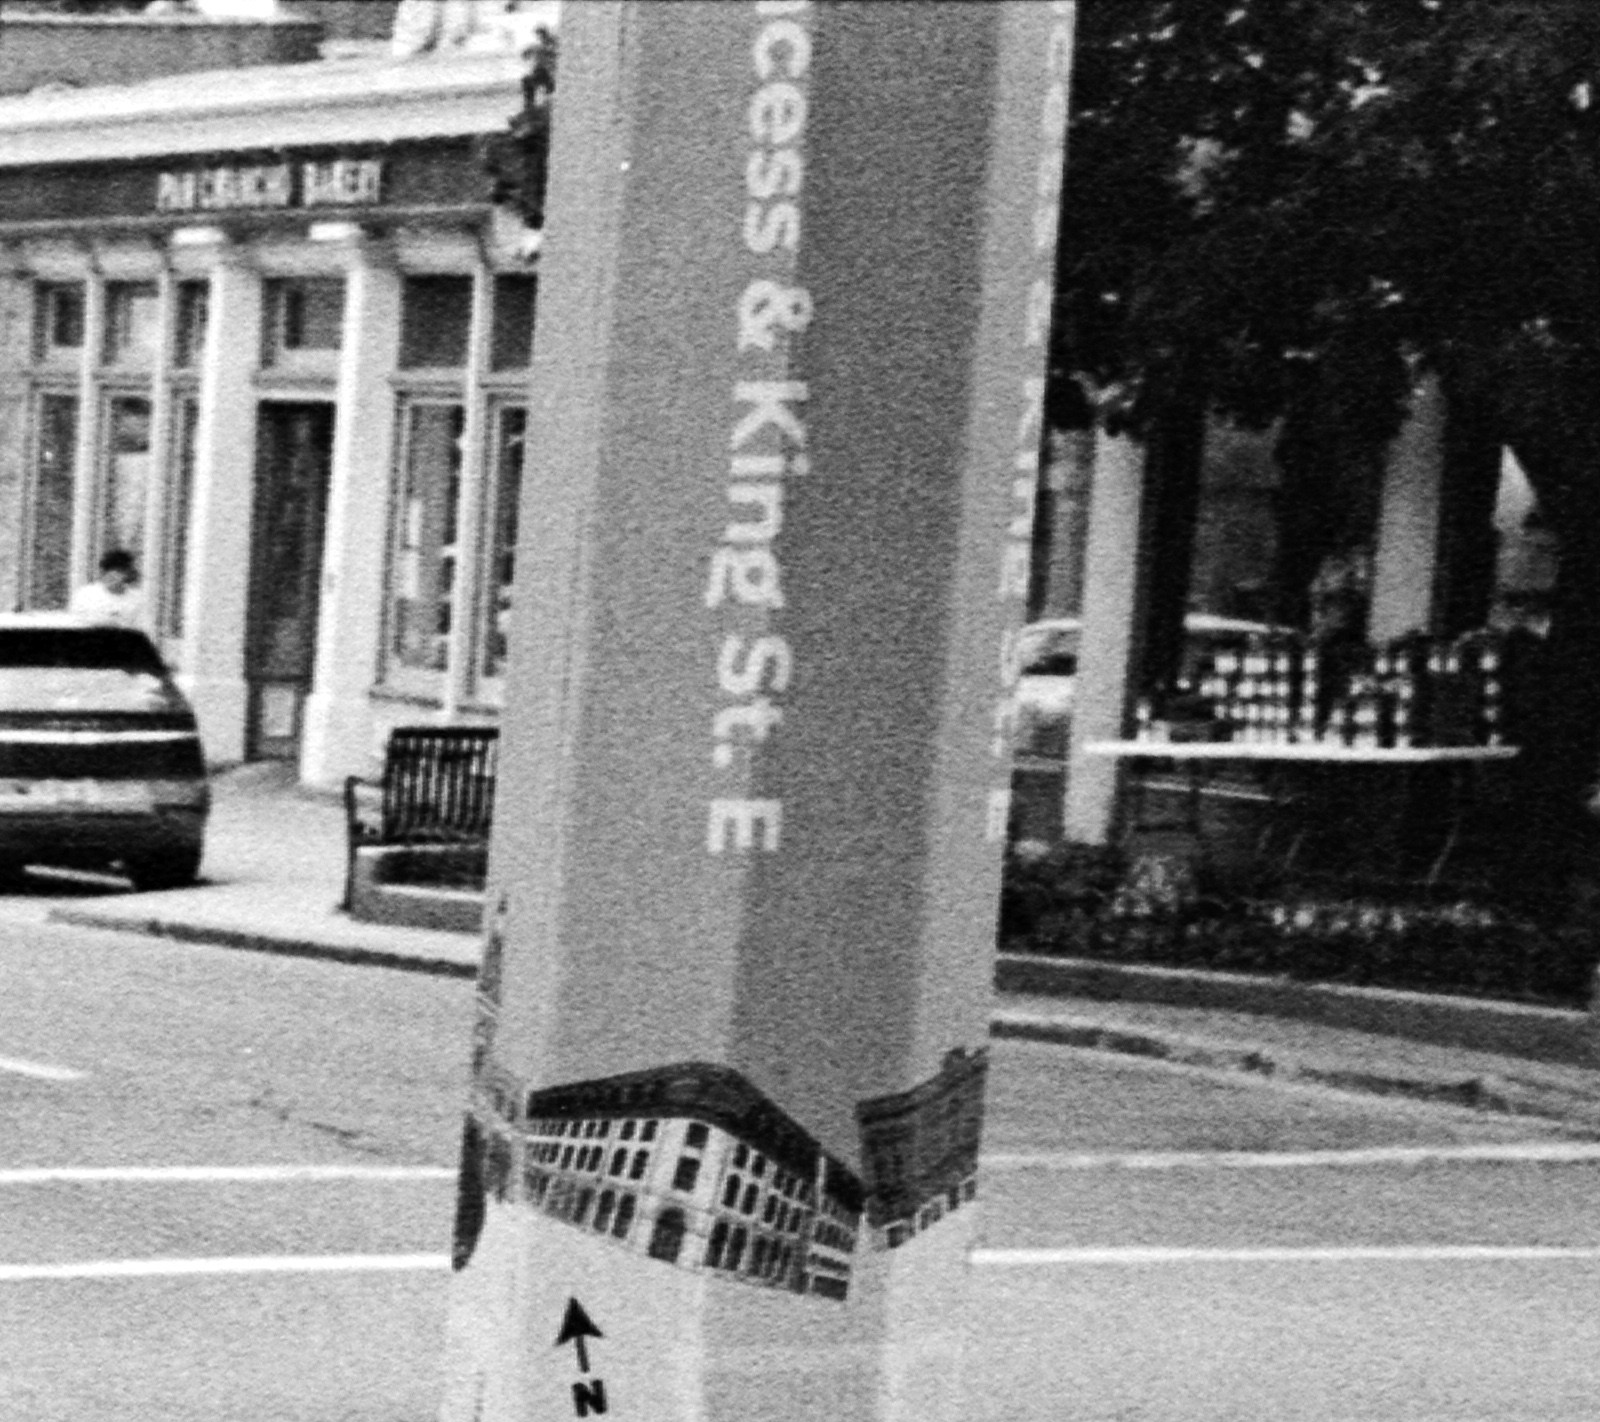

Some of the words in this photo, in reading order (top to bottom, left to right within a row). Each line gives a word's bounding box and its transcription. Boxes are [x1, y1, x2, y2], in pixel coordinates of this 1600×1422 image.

[743, 0, 813, 253] cess
[737, 279, 814, 353] &
[705, 380, 811, 608] King
[713, 634, 794, 769] St.
[705, 799, 784, 854] E
[572, 1378, 607, 1417] N
